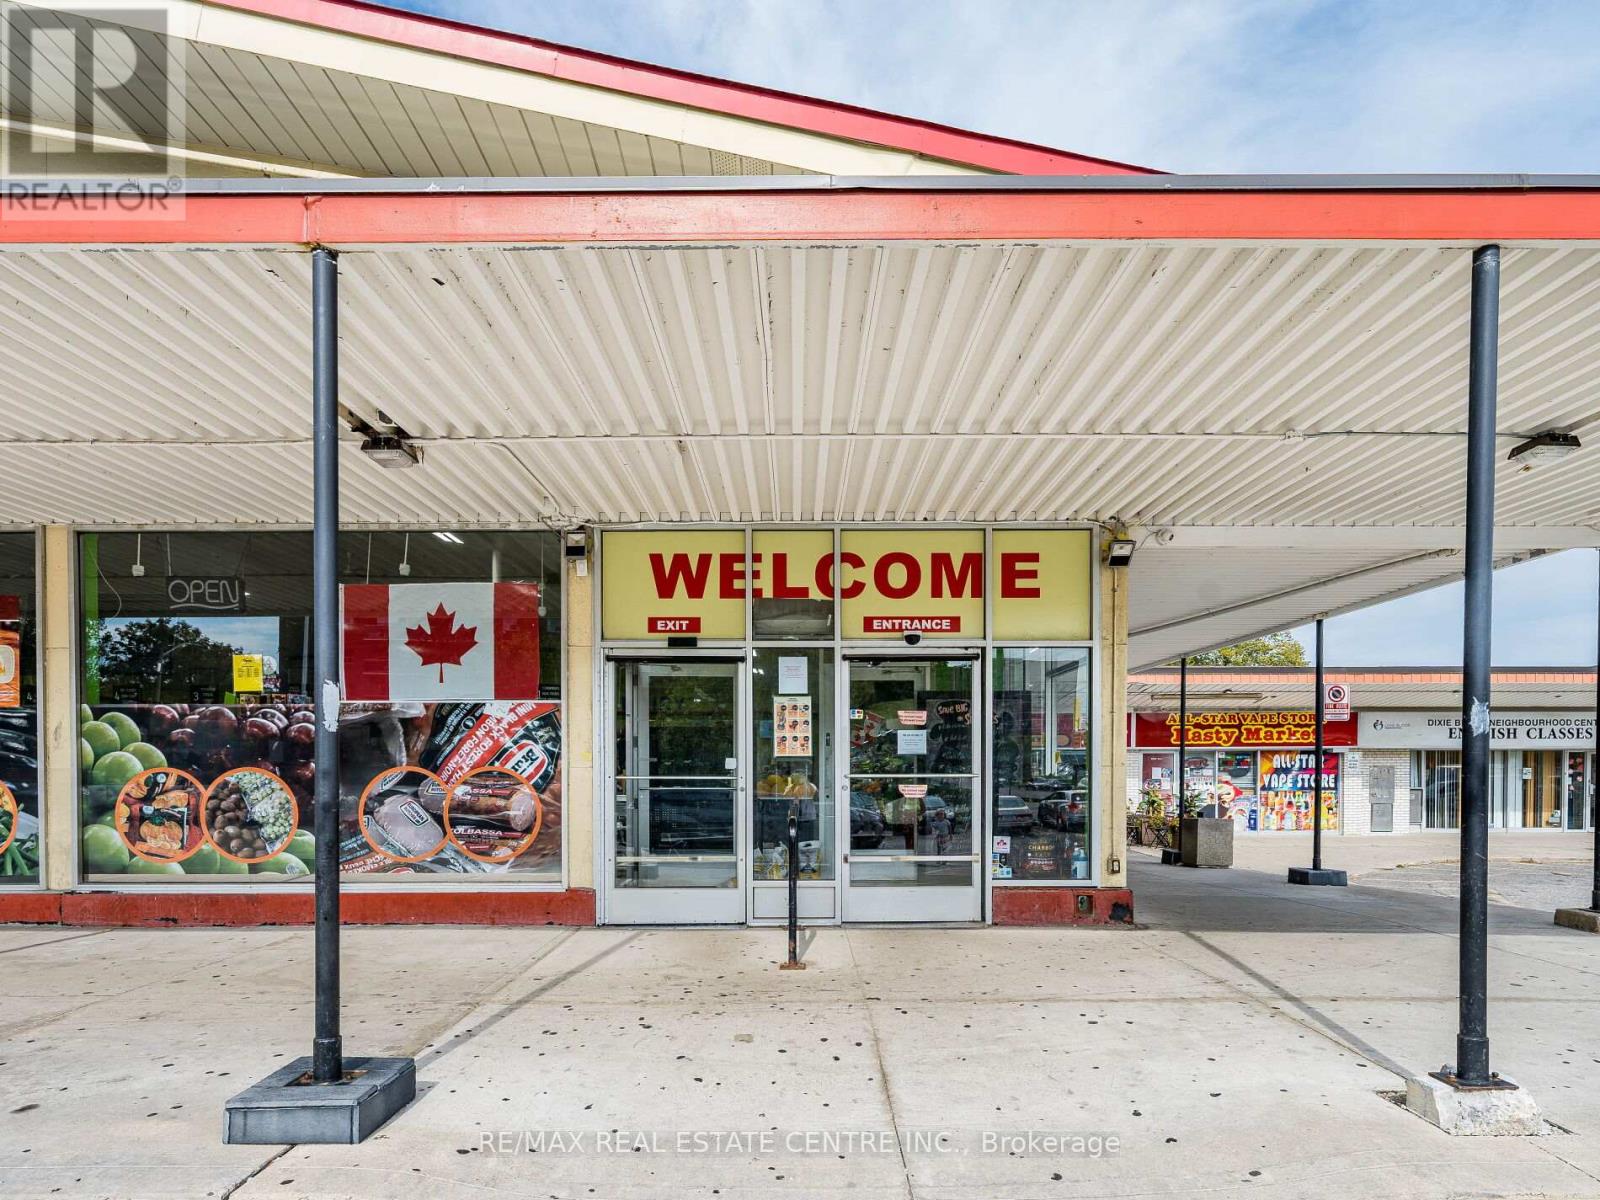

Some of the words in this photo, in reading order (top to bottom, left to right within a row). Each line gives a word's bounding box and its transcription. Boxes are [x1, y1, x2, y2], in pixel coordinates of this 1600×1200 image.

[649, 552, 1041, 599] WELCOME
[168, 580, 239, 603] OPEN
[656, 620, 690, 631] EXIT
[872, 619, 951, 630] ENTRANCE
[1166, 713, 1239, 724] AL-STAR
[1240, 713, 1277, 724] VAPE
[1279, 713, 1320, 724] STOR
[1427, 719, 1453, 727] DIXIE
[1490, 719, 1572, 727] NEIGHBOURHOOD
[1573, 719, 1598, 727] CENT
[1448, 727, 1517, 740] EISH
[1526, 727, 1594, 740] CLASSES
[1262, 773, 1294, 788] VAPE
